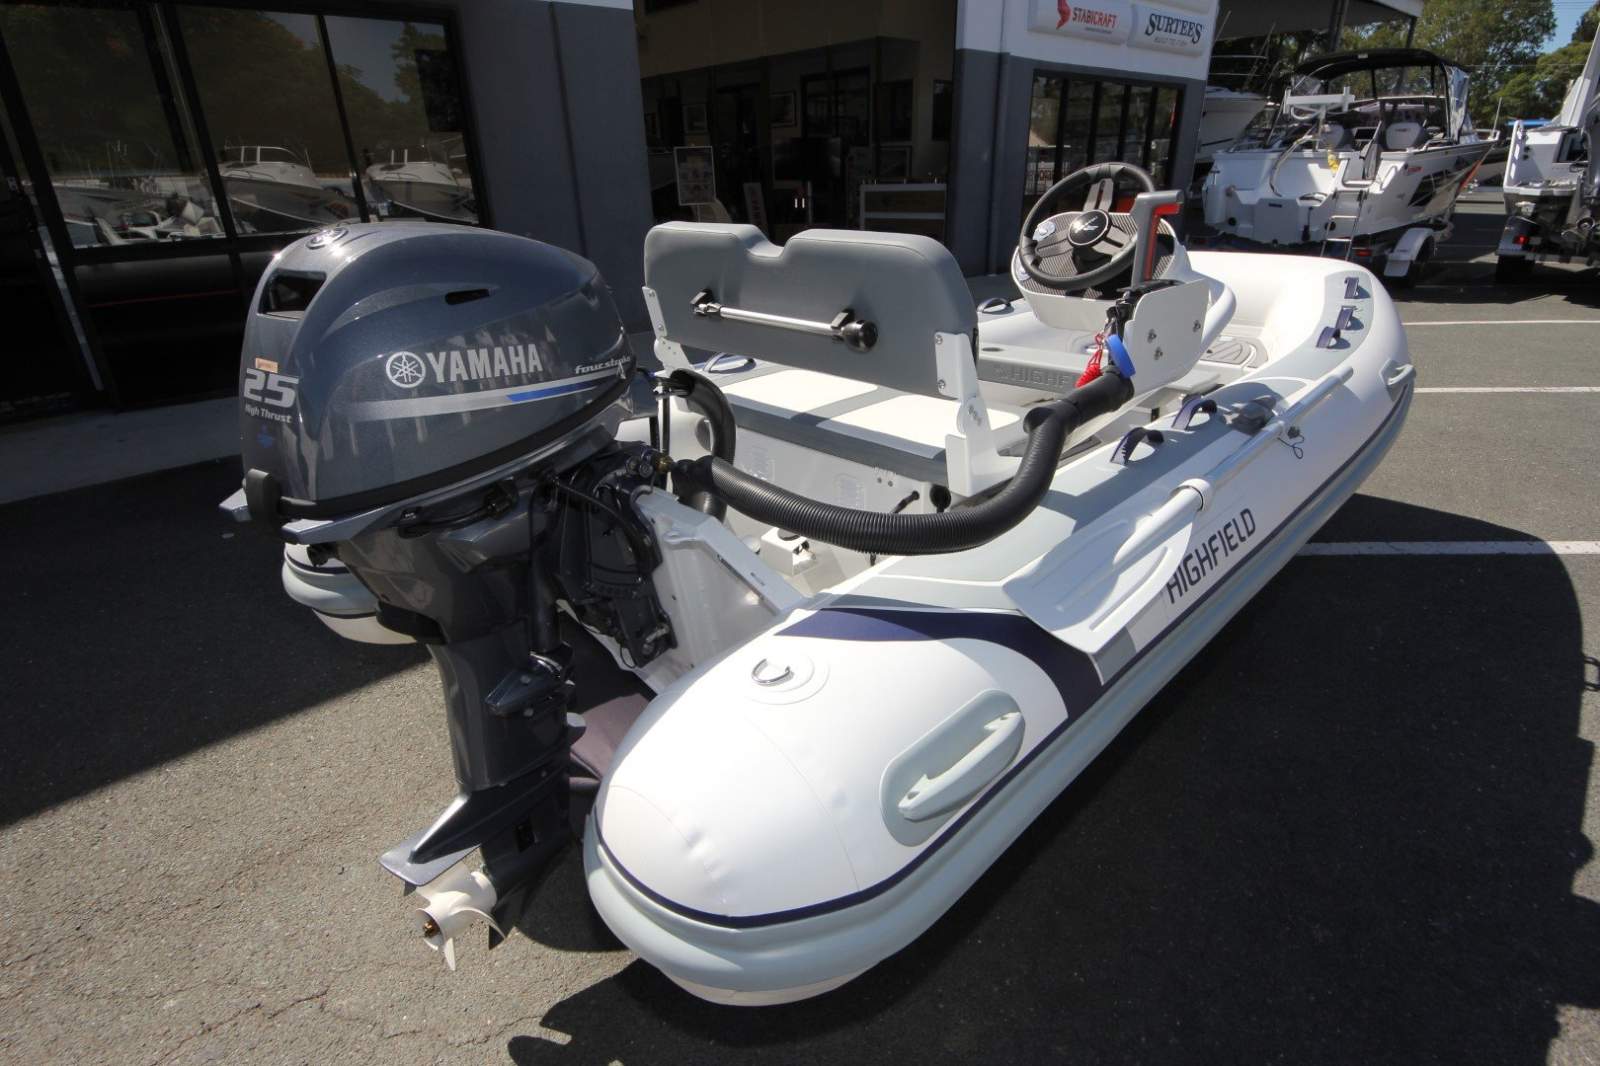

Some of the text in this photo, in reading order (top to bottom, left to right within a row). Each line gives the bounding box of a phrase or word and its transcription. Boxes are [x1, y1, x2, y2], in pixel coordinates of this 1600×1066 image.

[1072, 7, 1118, 29] STABICRAFT
[1145, 13, 1203, 45] SURTEES
[425, 343, 543, 383] YAMAHA
[244, 368, 299, 408] 25
[245, 403, 293, 424] High Thrust
[1166, 508, 1256, 604] HIGHFIELD
